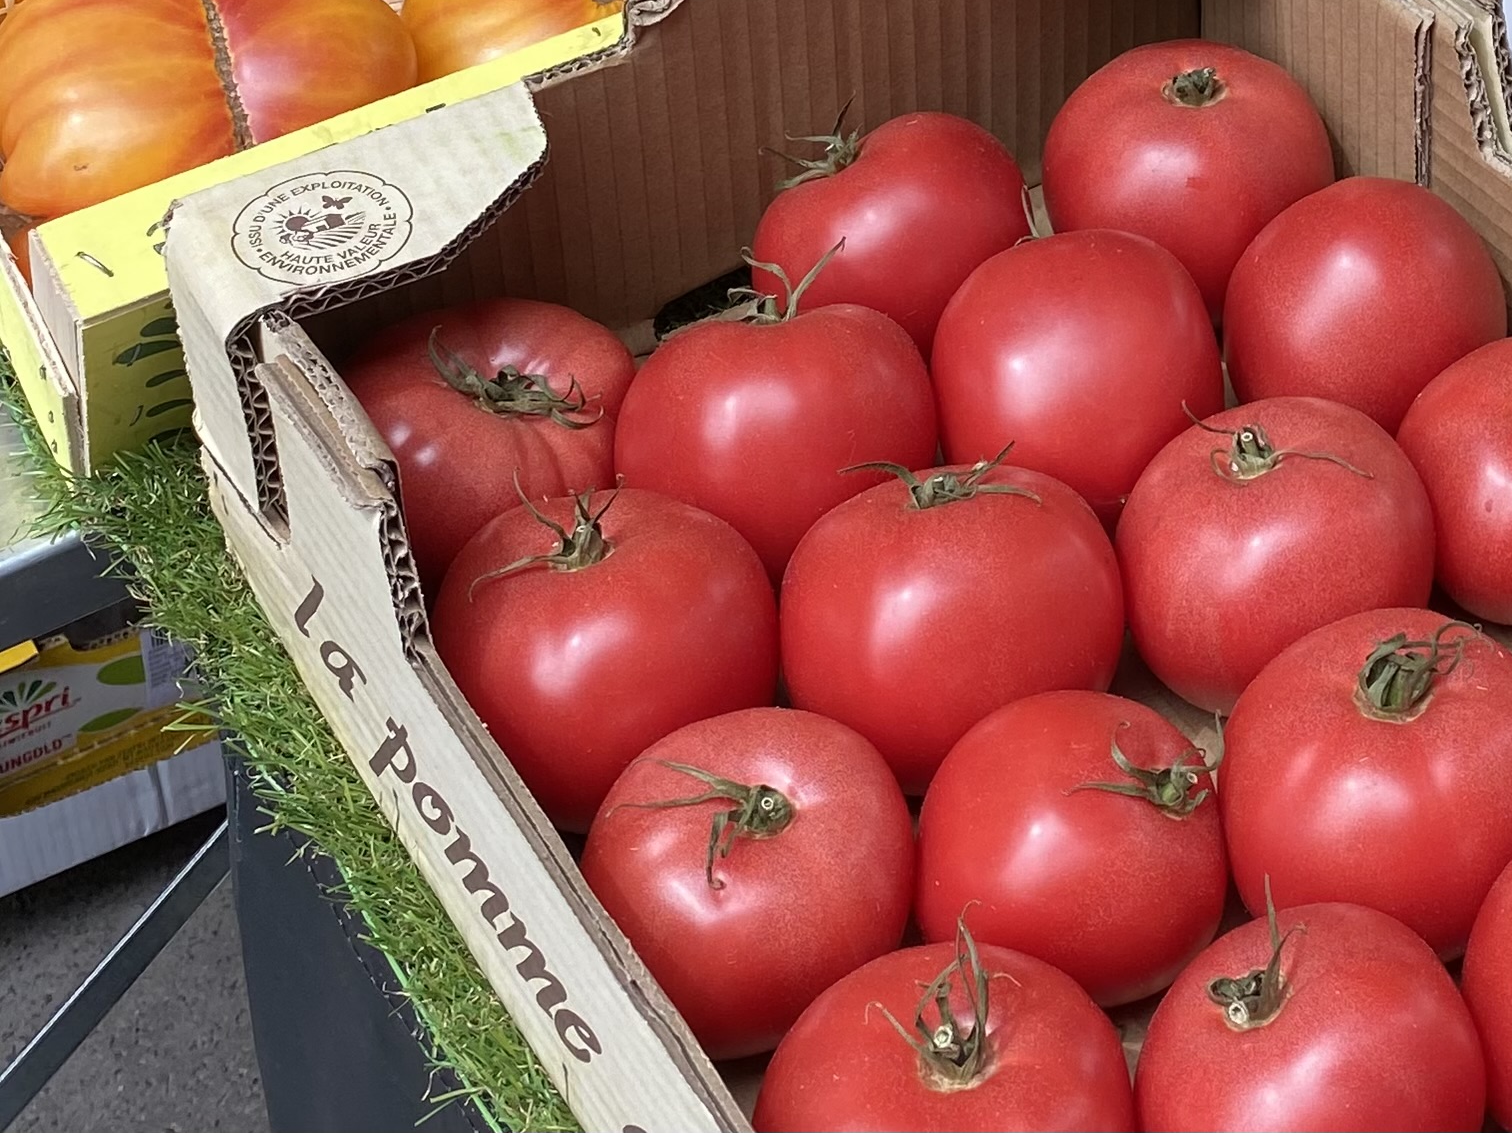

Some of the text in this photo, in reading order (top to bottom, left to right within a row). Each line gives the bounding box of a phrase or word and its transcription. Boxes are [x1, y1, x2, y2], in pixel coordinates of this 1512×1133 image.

[249, 180, 389, 248] ISSU D'UNE EXPLOITATION
[259, 212, 396, 275] ENVIRONNEMENTALE
[280, 223, 381, 265] HAUTE VALEUR
[2, 685, 70, 729] spri
[0, 738, 63, 774] UNGOLD
[295, 574, 603, 1063] la pomme
